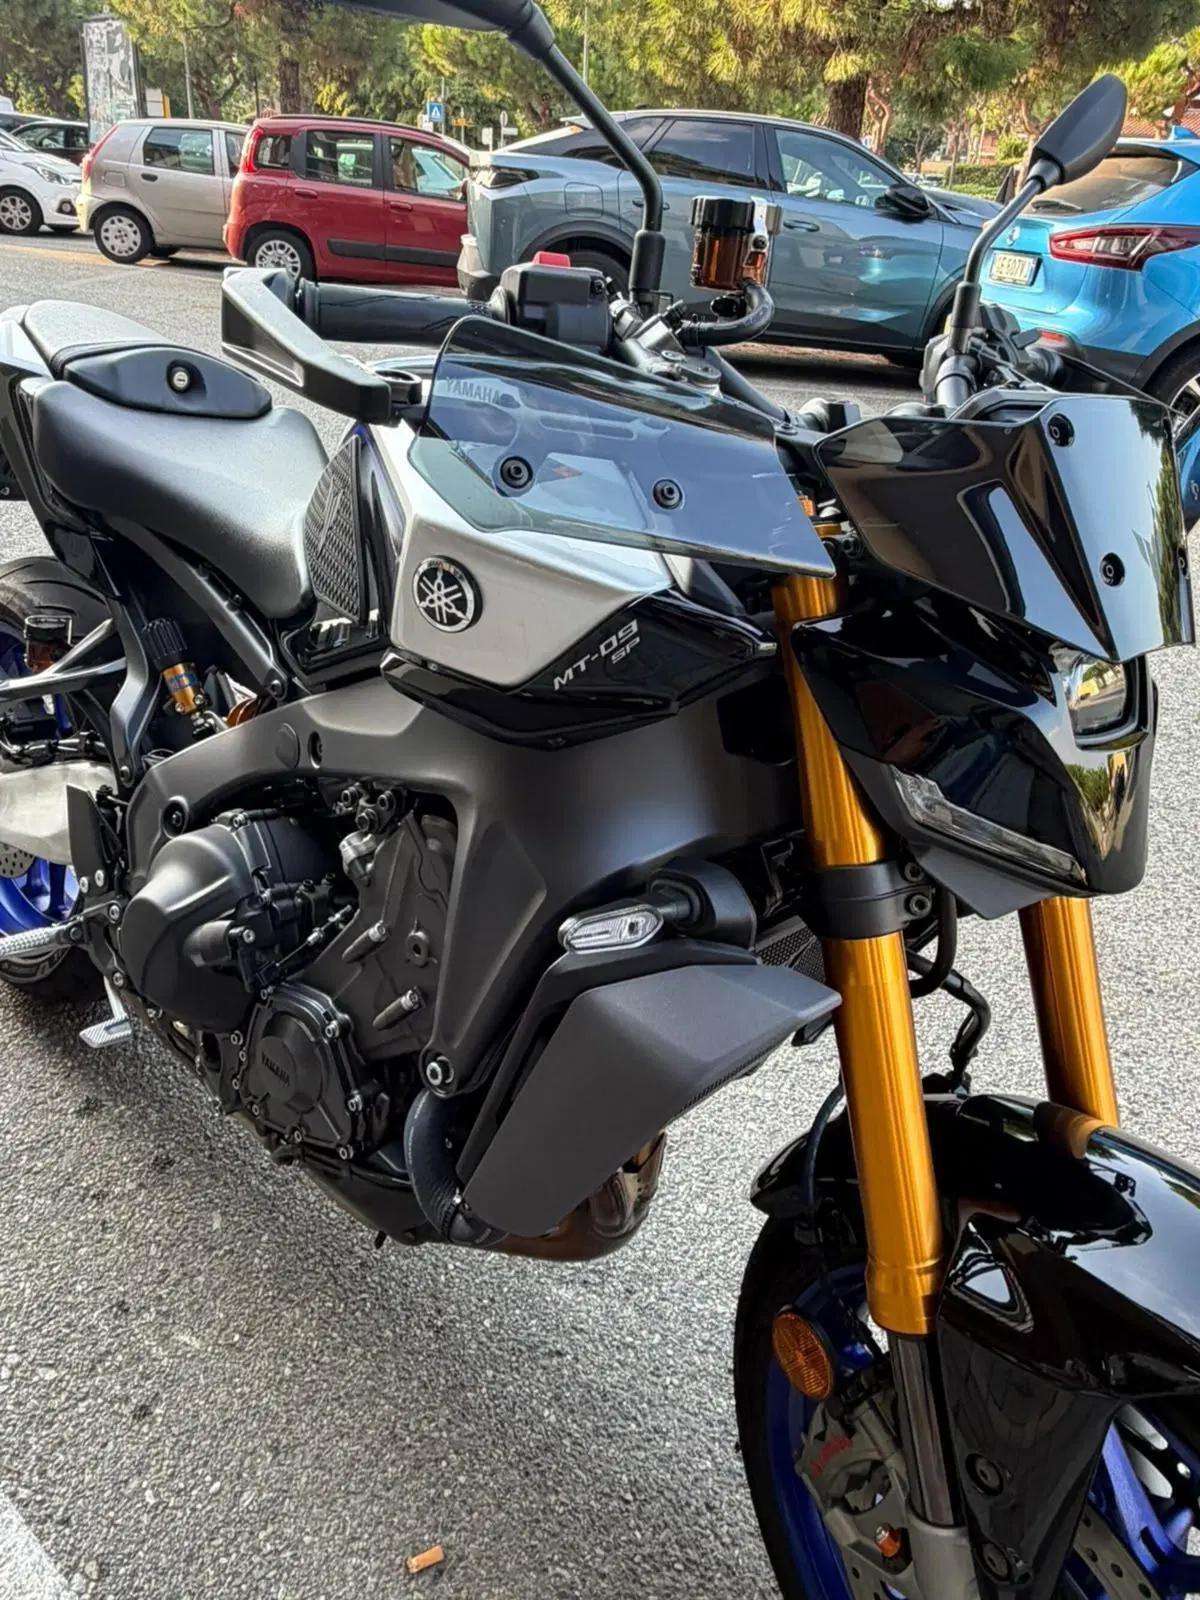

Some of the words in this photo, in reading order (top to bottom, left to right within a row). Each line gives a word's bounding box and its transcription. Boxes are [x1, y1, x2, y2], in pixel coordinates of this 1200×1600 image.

[445, 377, 501, 404] YAMAHA
[553, 619, 638, 691] MT-09
[611, 636, 640, 664] SP
